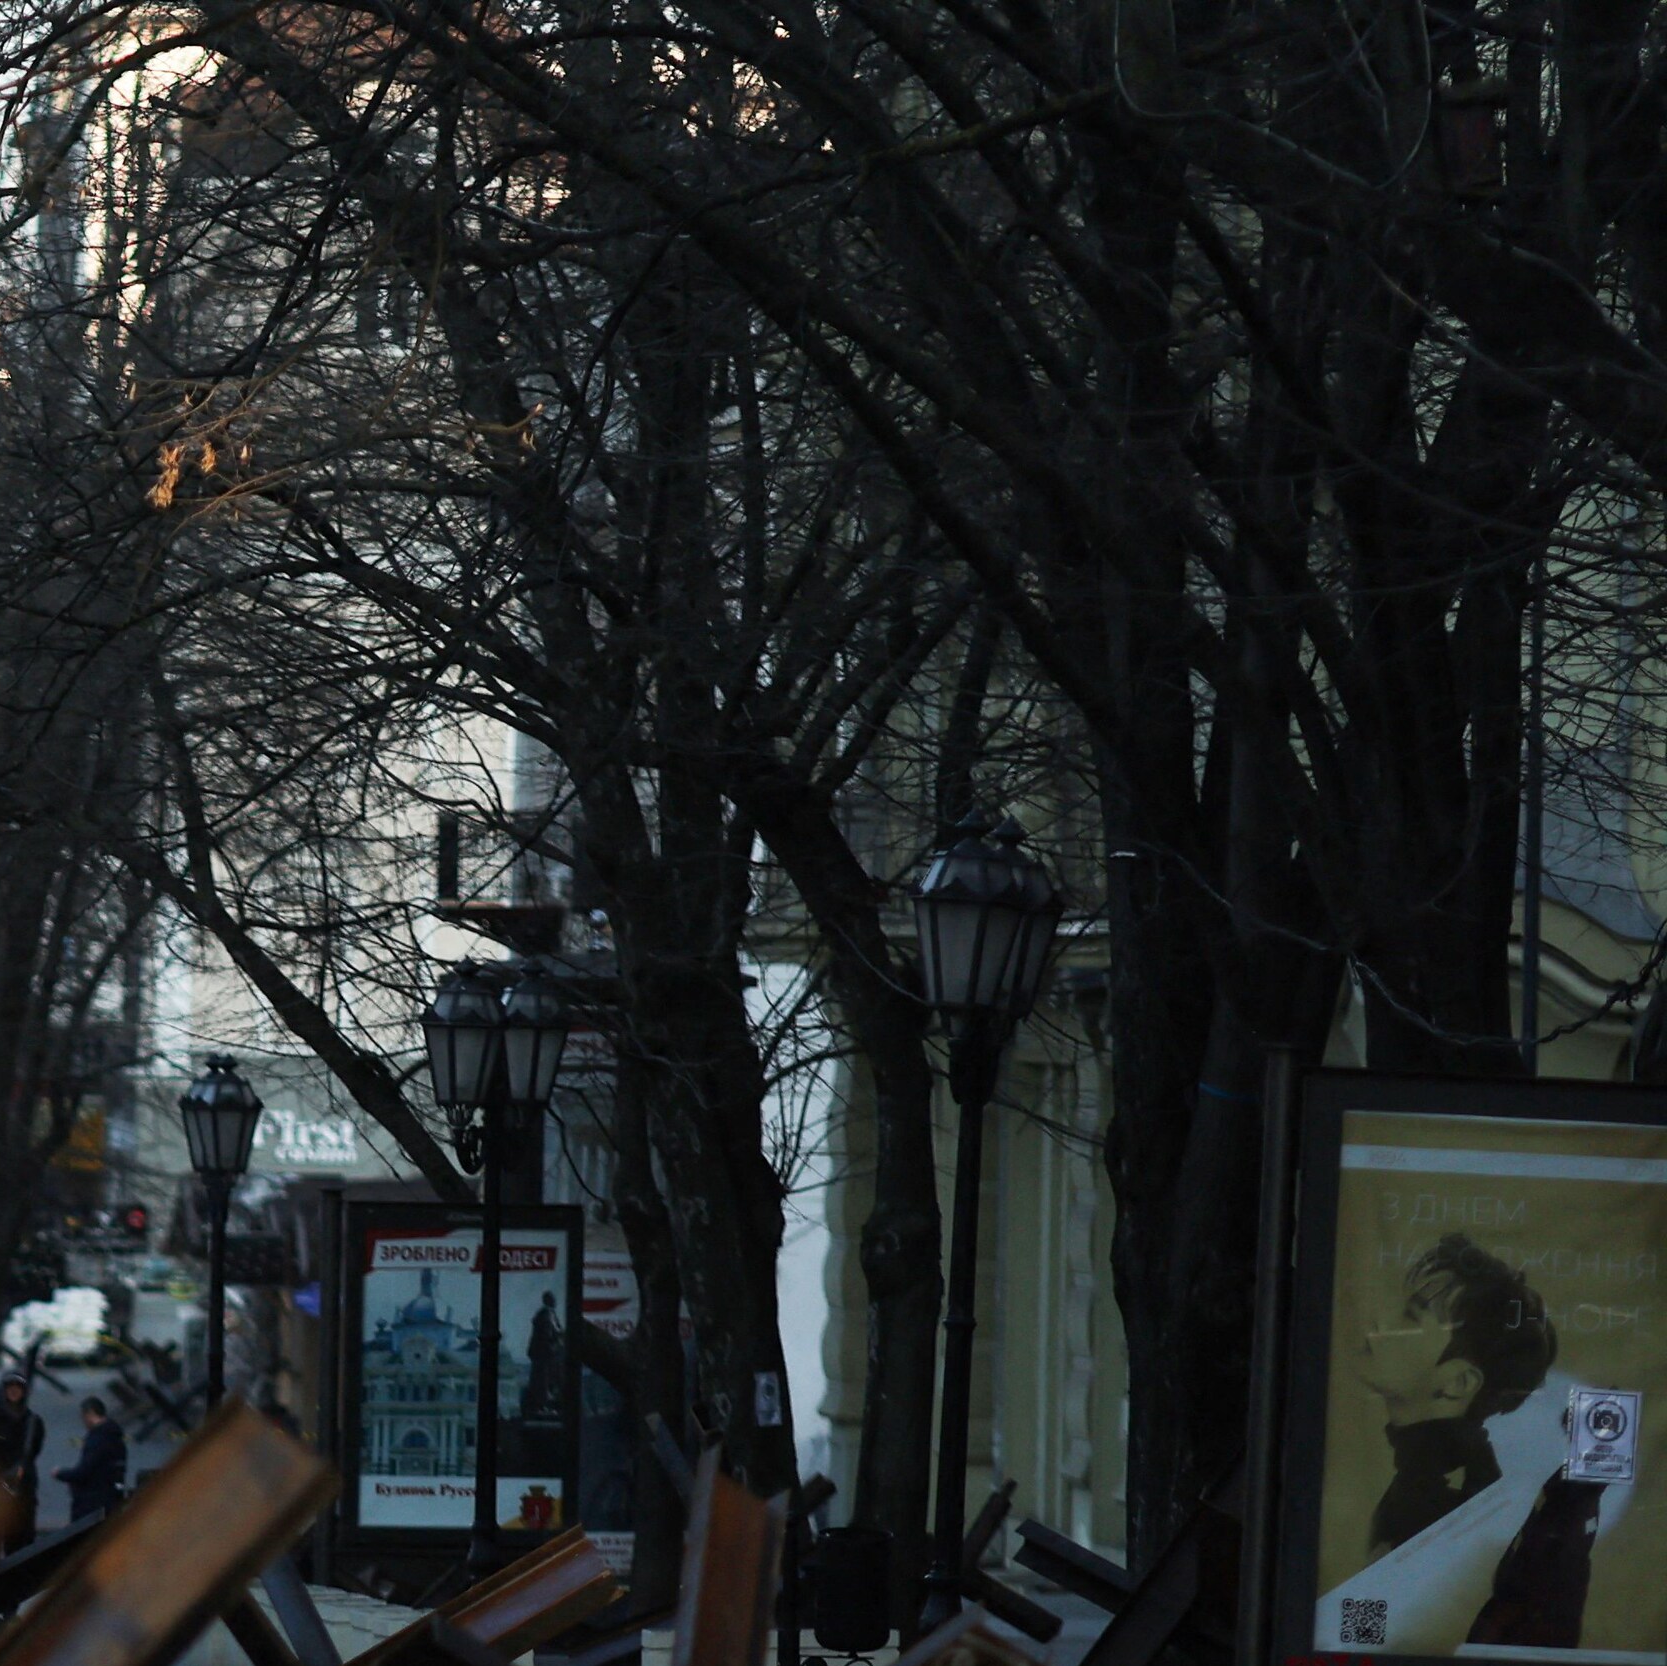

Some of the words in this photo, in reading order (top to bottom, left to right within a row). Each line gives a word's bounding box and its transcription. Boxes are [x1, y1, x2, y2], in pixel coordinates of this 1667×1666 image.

[252, 1110, 355, 1146] First
[1409, 1193, 1527, 1225] ДНЕМ
[380, 1244, 471, 1263] ЗРОБЛЕНО
[499, 1249, 549, 1268] ОДЕСІ
[1505, 1299, 1652, 1334] J-HOPE
